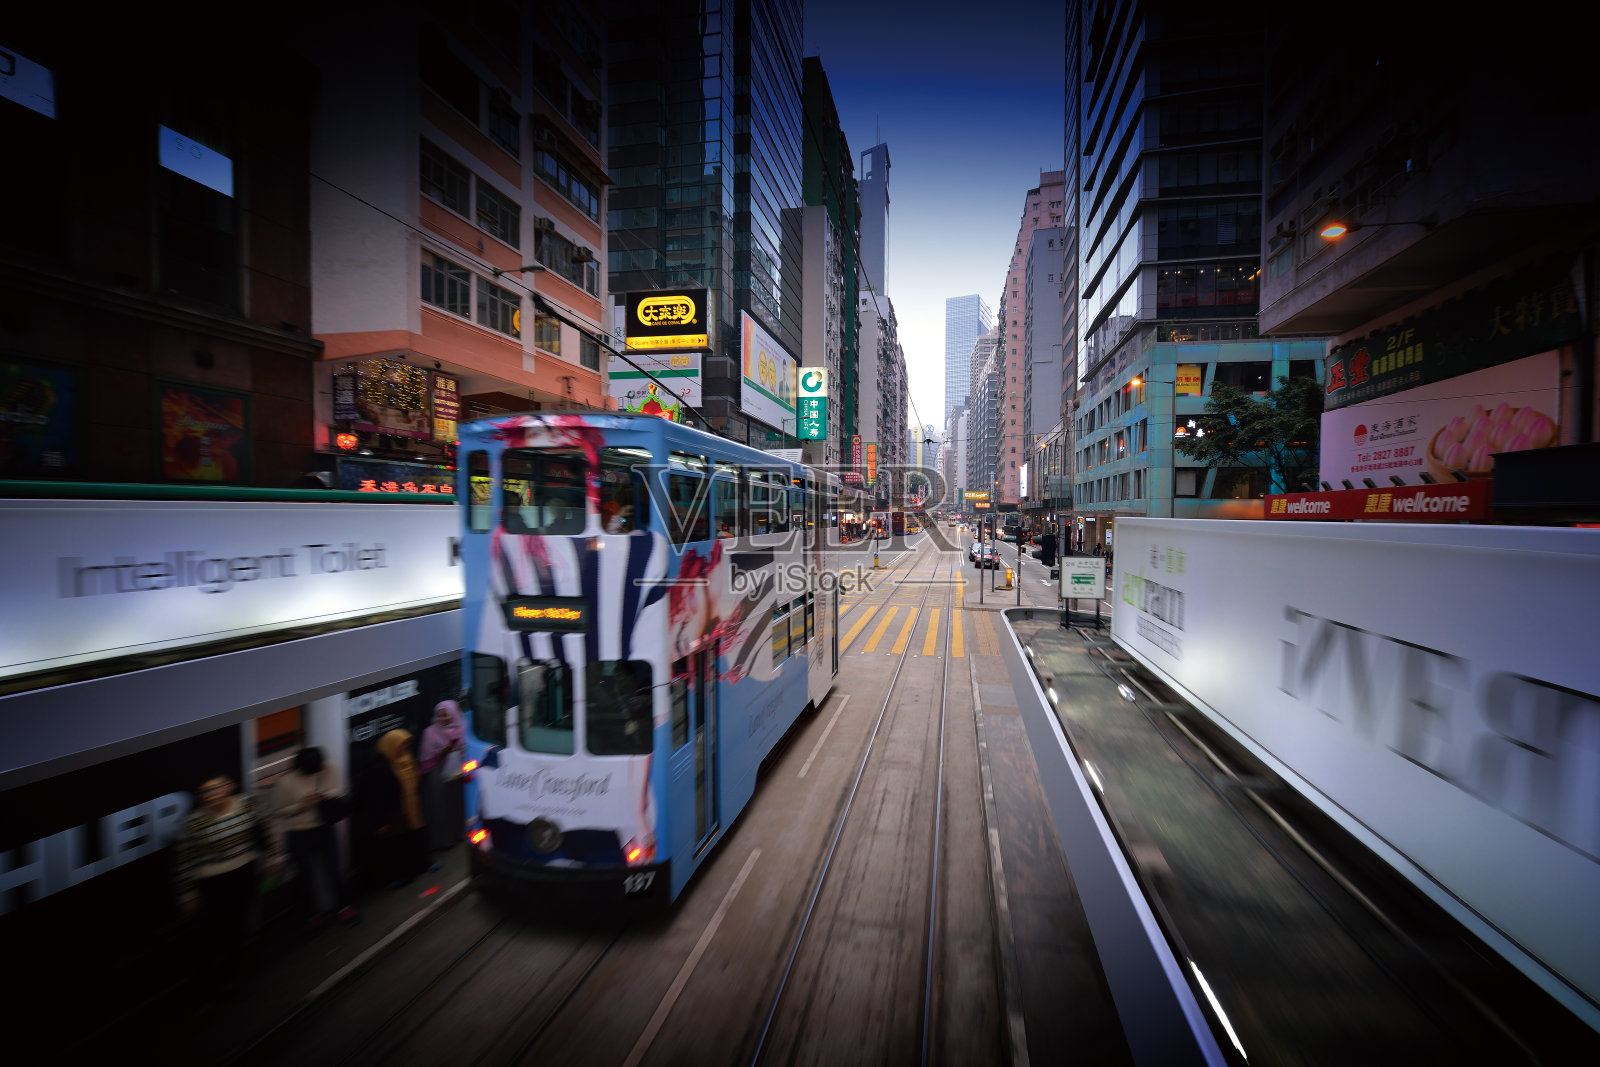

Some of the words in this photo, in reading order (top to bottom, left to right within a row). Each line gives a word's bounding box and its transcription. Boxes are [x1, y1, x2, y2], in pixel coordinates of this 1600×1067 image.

[1386, 328, 1416, 351] 2/F
[809, 399, 820, 438] 中国人寿
[1357, 453, 1372, 463] Tel:
[1373, 449, 1391, 461] 2827
[1393, 446, 1415, 458] 8887
[1271, 498, 1288, 514] 惠康
[1287, 497, 1332, 514] wellcome
[1364, 493, 1393, 513] 惠康
[1393, 491, 1470, 513] wellcome
[57, 547, 299, 598] Intelligent
[301, 542, 389, 576] Toilet
